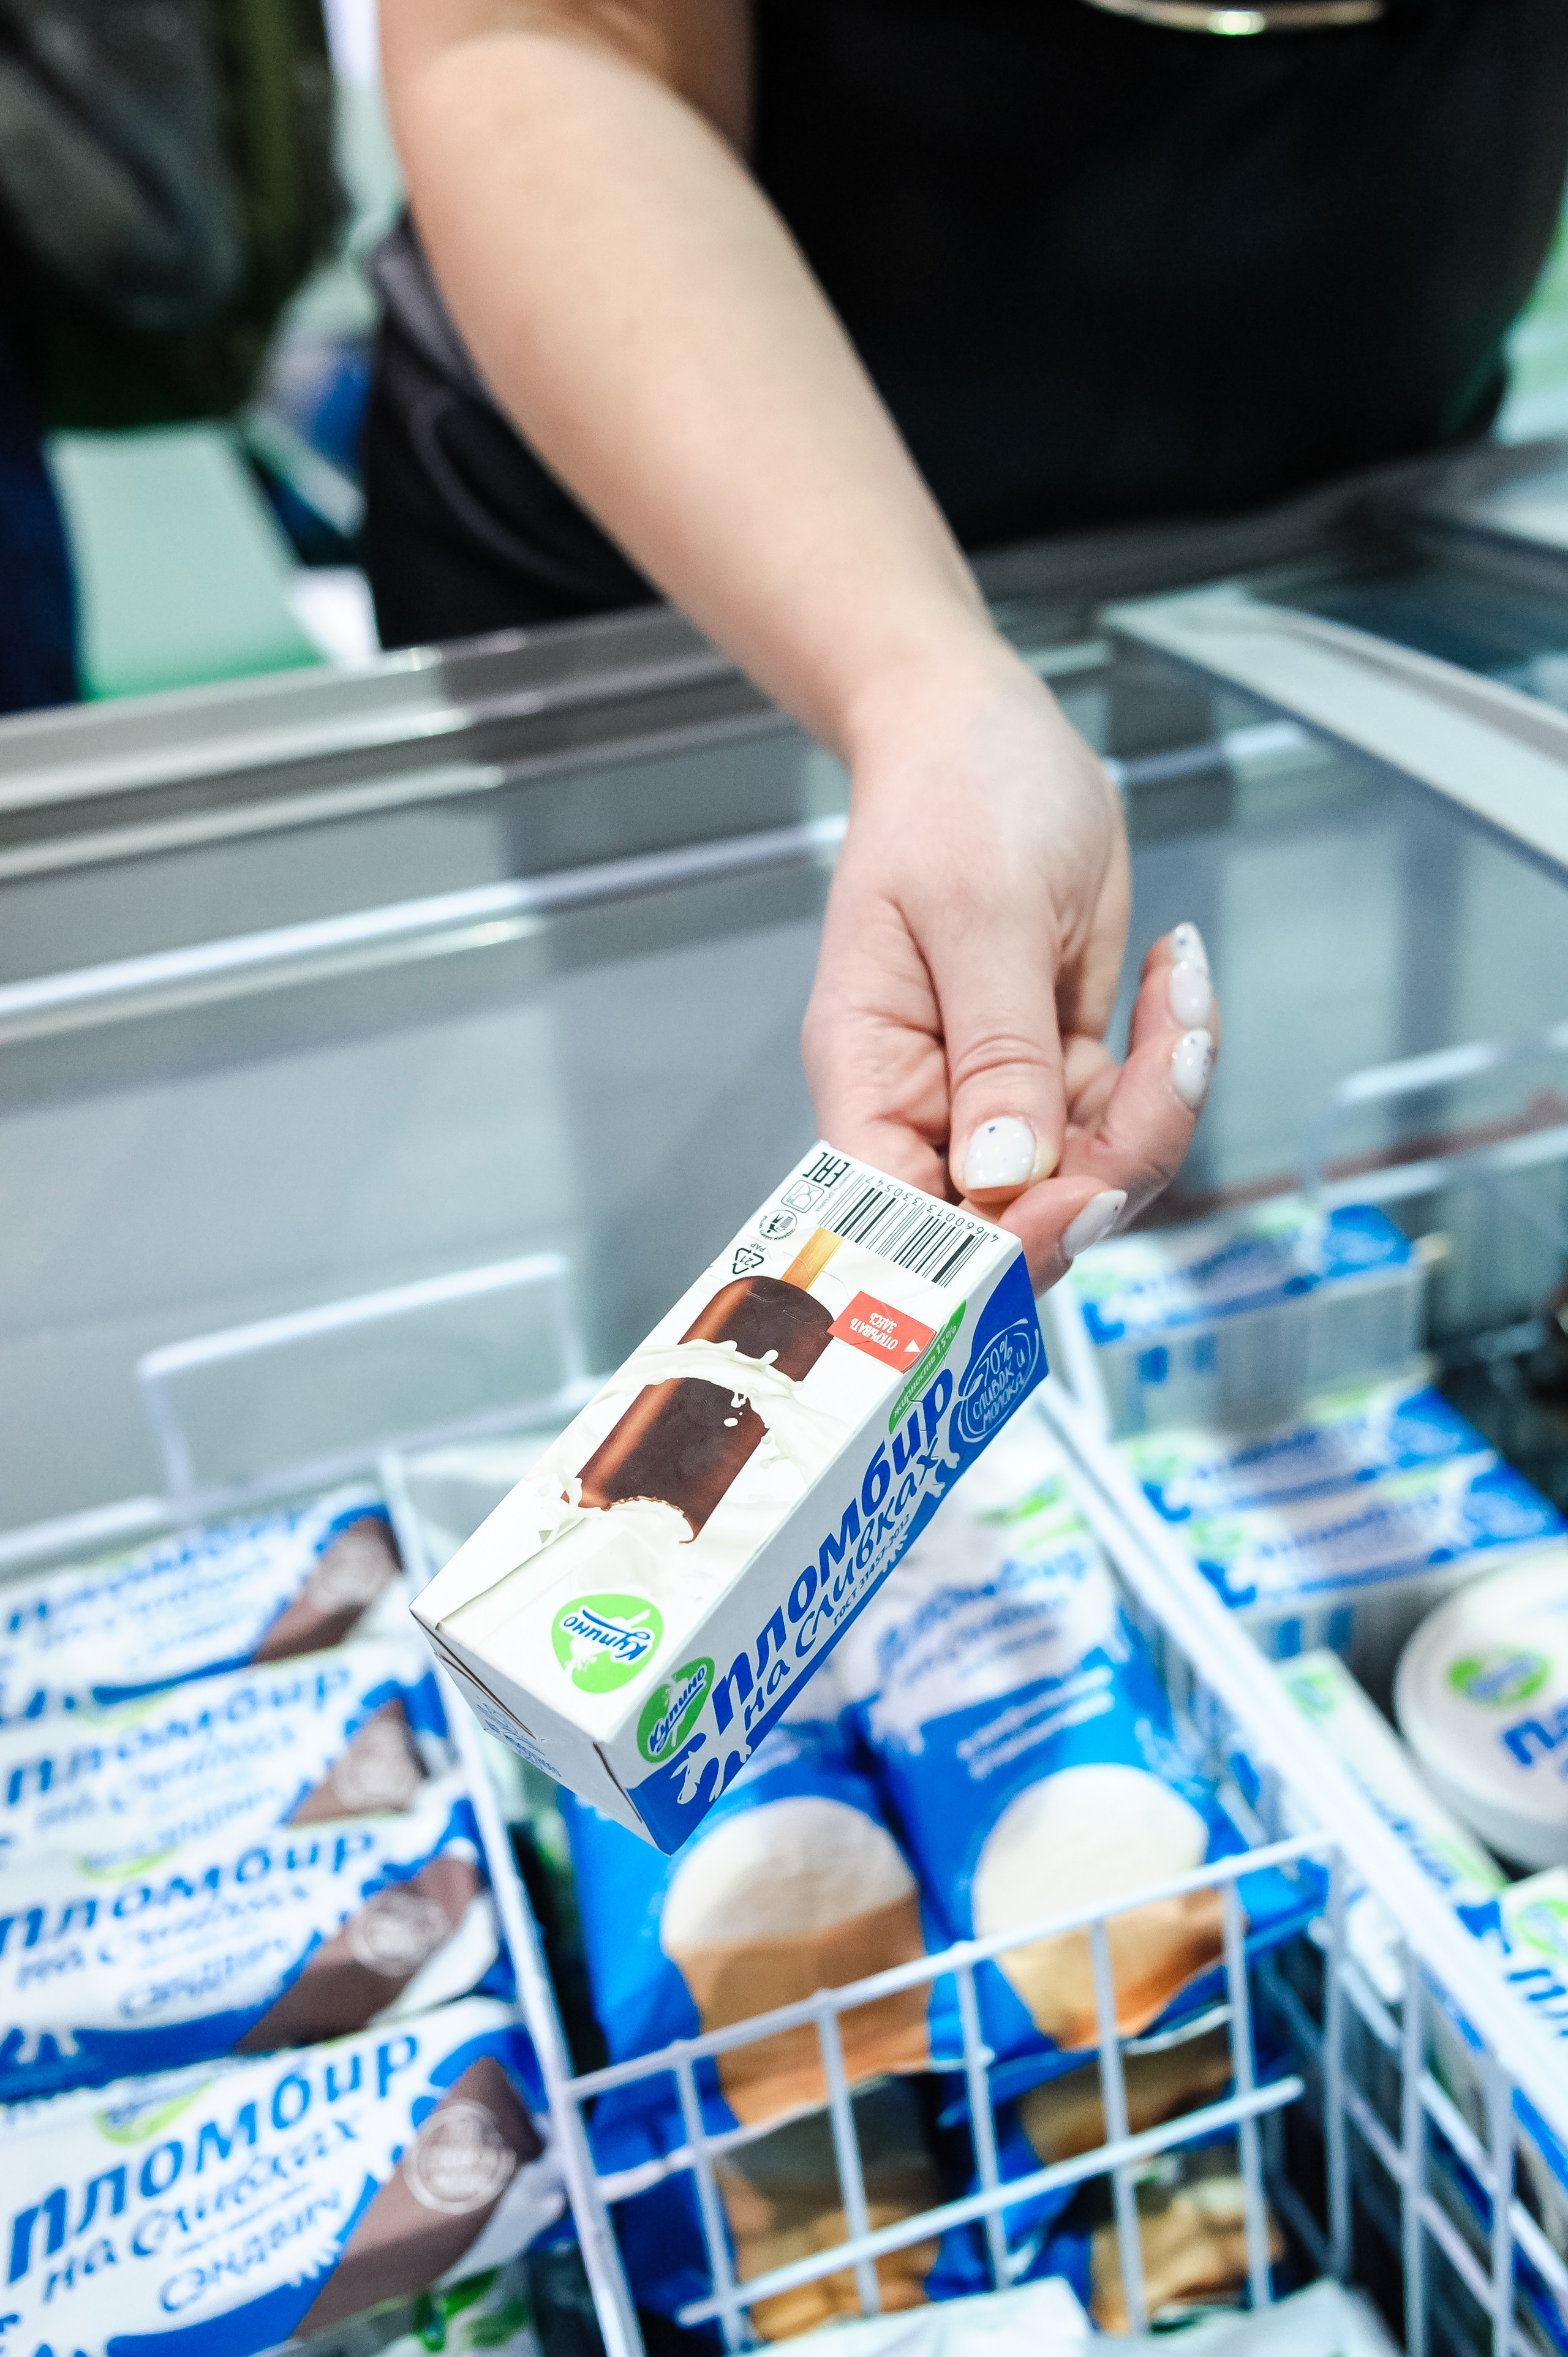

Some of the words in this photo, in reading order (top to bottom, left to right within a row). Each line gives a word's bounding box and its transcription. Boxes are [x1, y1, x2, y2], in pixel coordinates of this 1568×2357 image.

[865, 1176, 922, 1206] 330547
[927, 1204, 984, 1234] 660013
[739, 1256, 753, 1265] 21
[750, 1243, 766, 1252] PAP
[850, 1318, 899, 1350] ОТКРЫВАТЬ
[870, 1312, 898, 1333] ЗДЕСЬ
[894, 1356, 937, 1419] жирность
[935, 1325, 957, 1354] 15%
[979, 1335, 1013, 1387] 70%
[833, 1583, 859, 1626] ГОСТ
[564, 1608, 650, 1662] Купино
[649, 1664, 706, 1753] Купино
[742, 1664, 788, 1722] на
